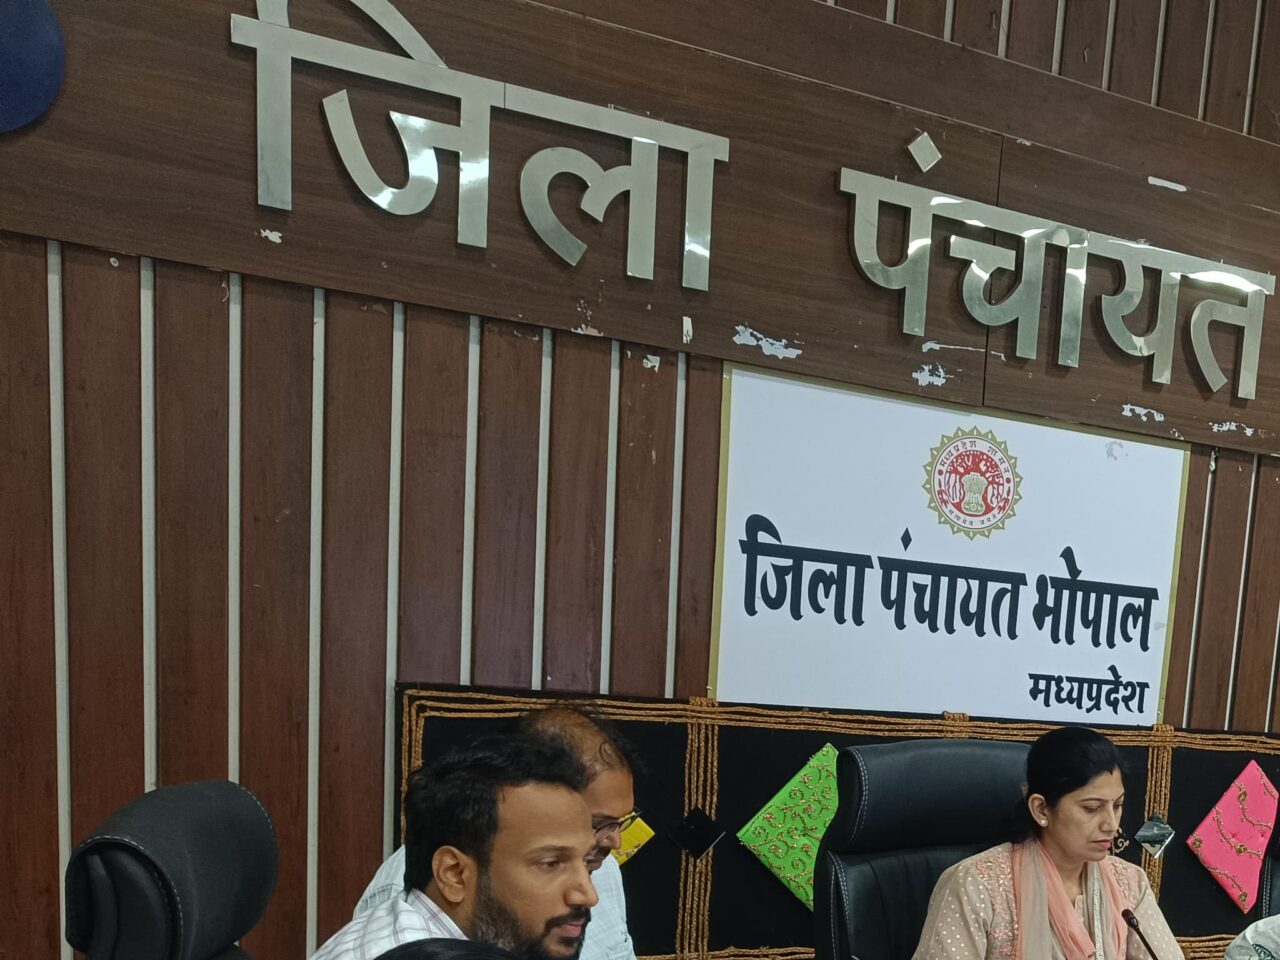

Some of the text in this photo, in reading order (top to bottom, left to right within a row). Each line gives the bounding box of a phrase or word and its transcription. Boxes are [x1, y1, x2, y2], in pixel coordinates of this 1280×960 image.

[231, 0, 730, 291] जिला
[839, 131, 1275, 400] पंचायत
[738, 513, 1159, 652] जिला पंचायत भोपाल
[1028, 665, 1150, 714] मध्यप्रदेश
